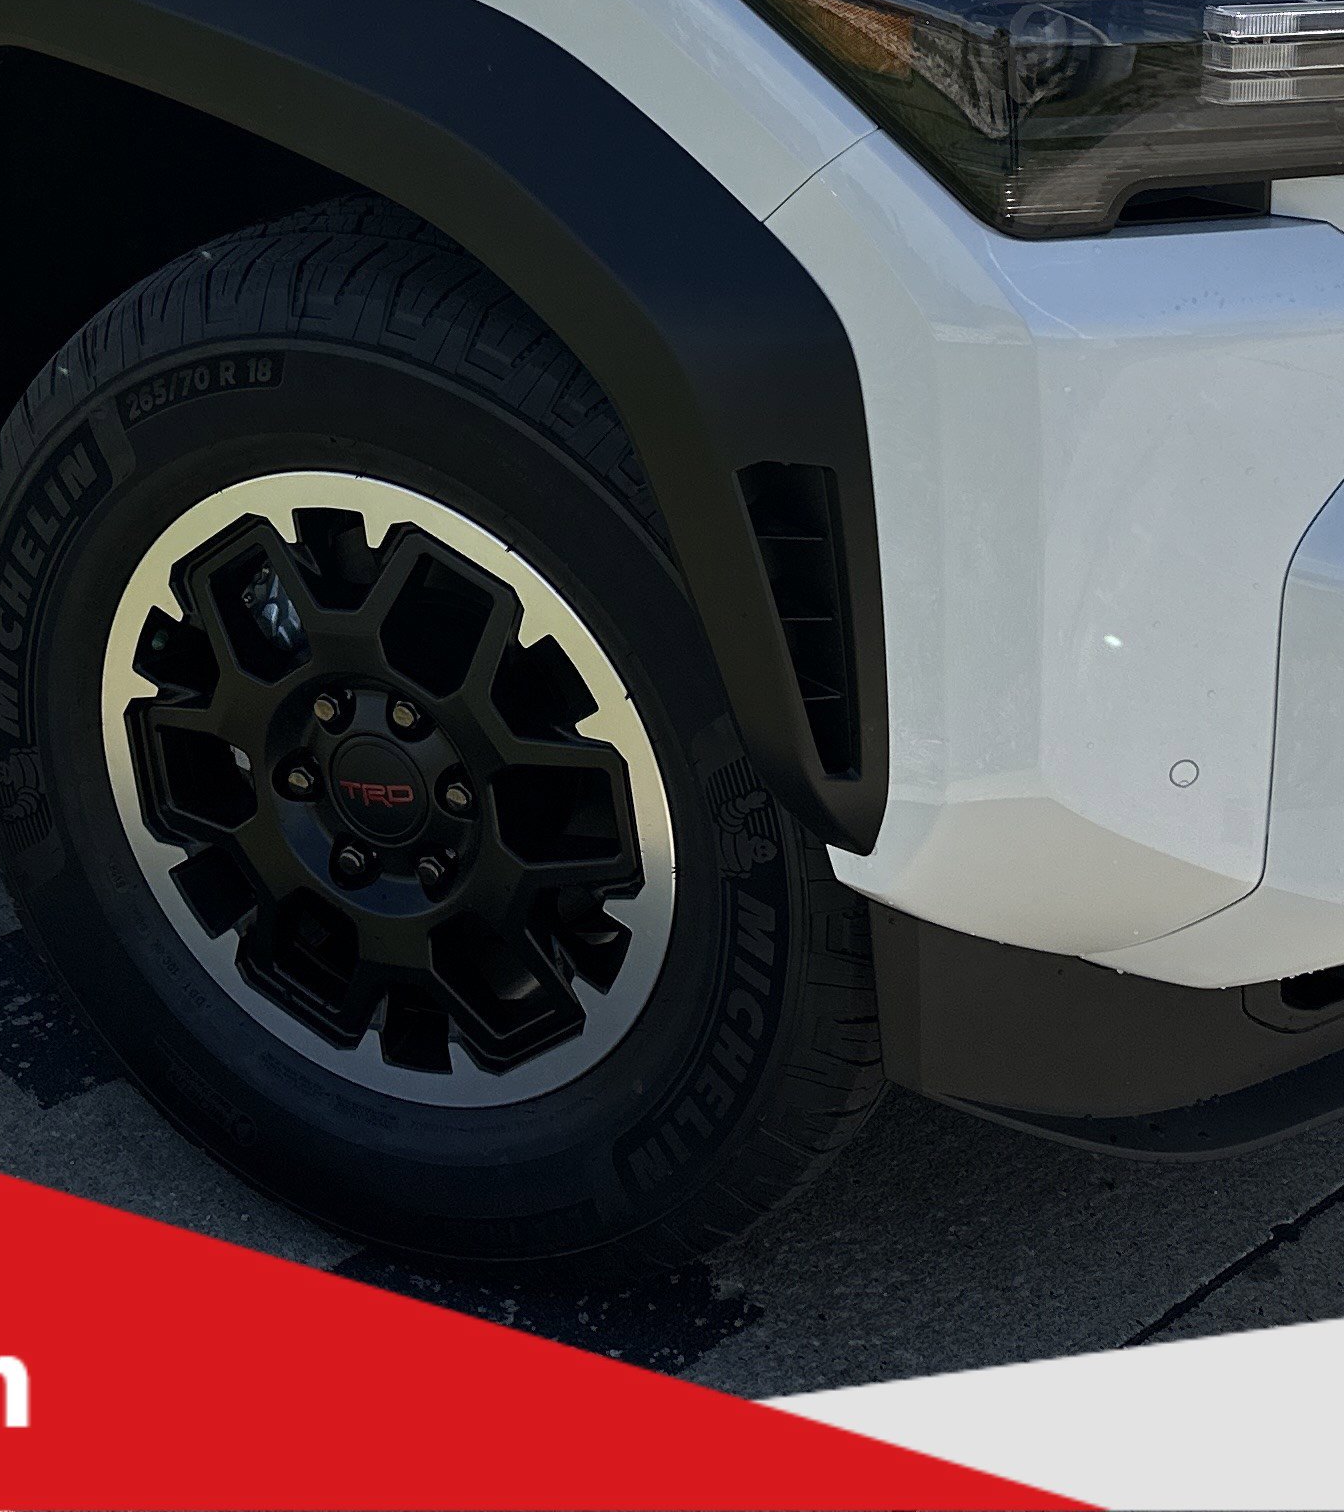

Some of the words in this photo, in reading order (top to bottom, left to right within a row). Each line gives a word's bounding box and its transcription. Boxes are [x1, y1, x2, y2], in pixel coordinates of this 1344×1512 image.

[219, 359, 237, 387] R
[246, 357, 273, 383] 18
[339, 779, 415, 808] TRD
[627, 890, 777, 1192] MICHELIN
